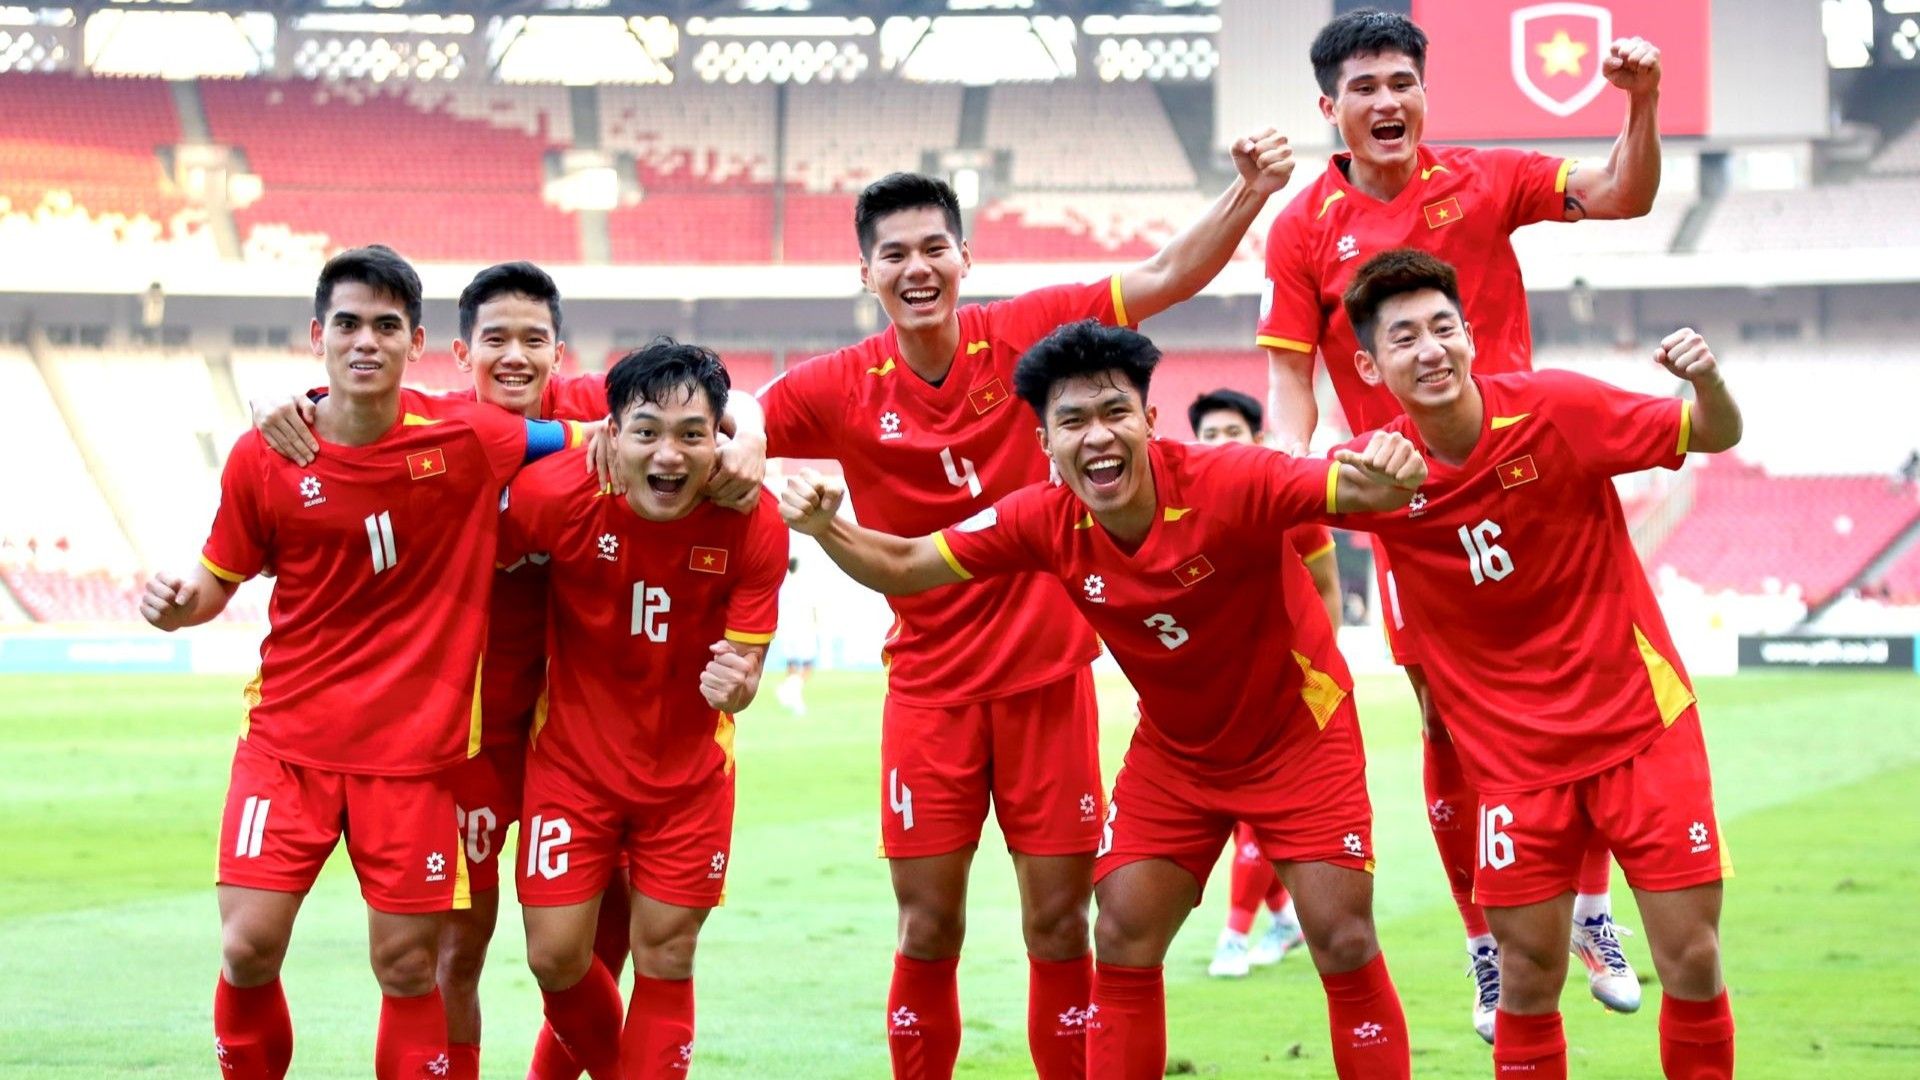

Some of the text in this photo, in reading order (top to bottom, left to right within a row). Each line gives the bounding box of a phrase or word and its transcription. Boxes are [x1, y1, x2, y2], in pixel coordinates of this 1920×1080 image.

[939, 446, 983, 499] 4
[364, 510, 397, 574] 11
[1457, 518, 1515, 586] 16
[630, 580, 671, 643] 12
[1143, 613, 1190, 650] 3
[235, 796, 271, 858] 11
[889, 767, 914, 831] 4
[456, 803, 497, 864] 0
[526, 814, 572, 881] 12
[1478, 803, 1516, 871] 16
